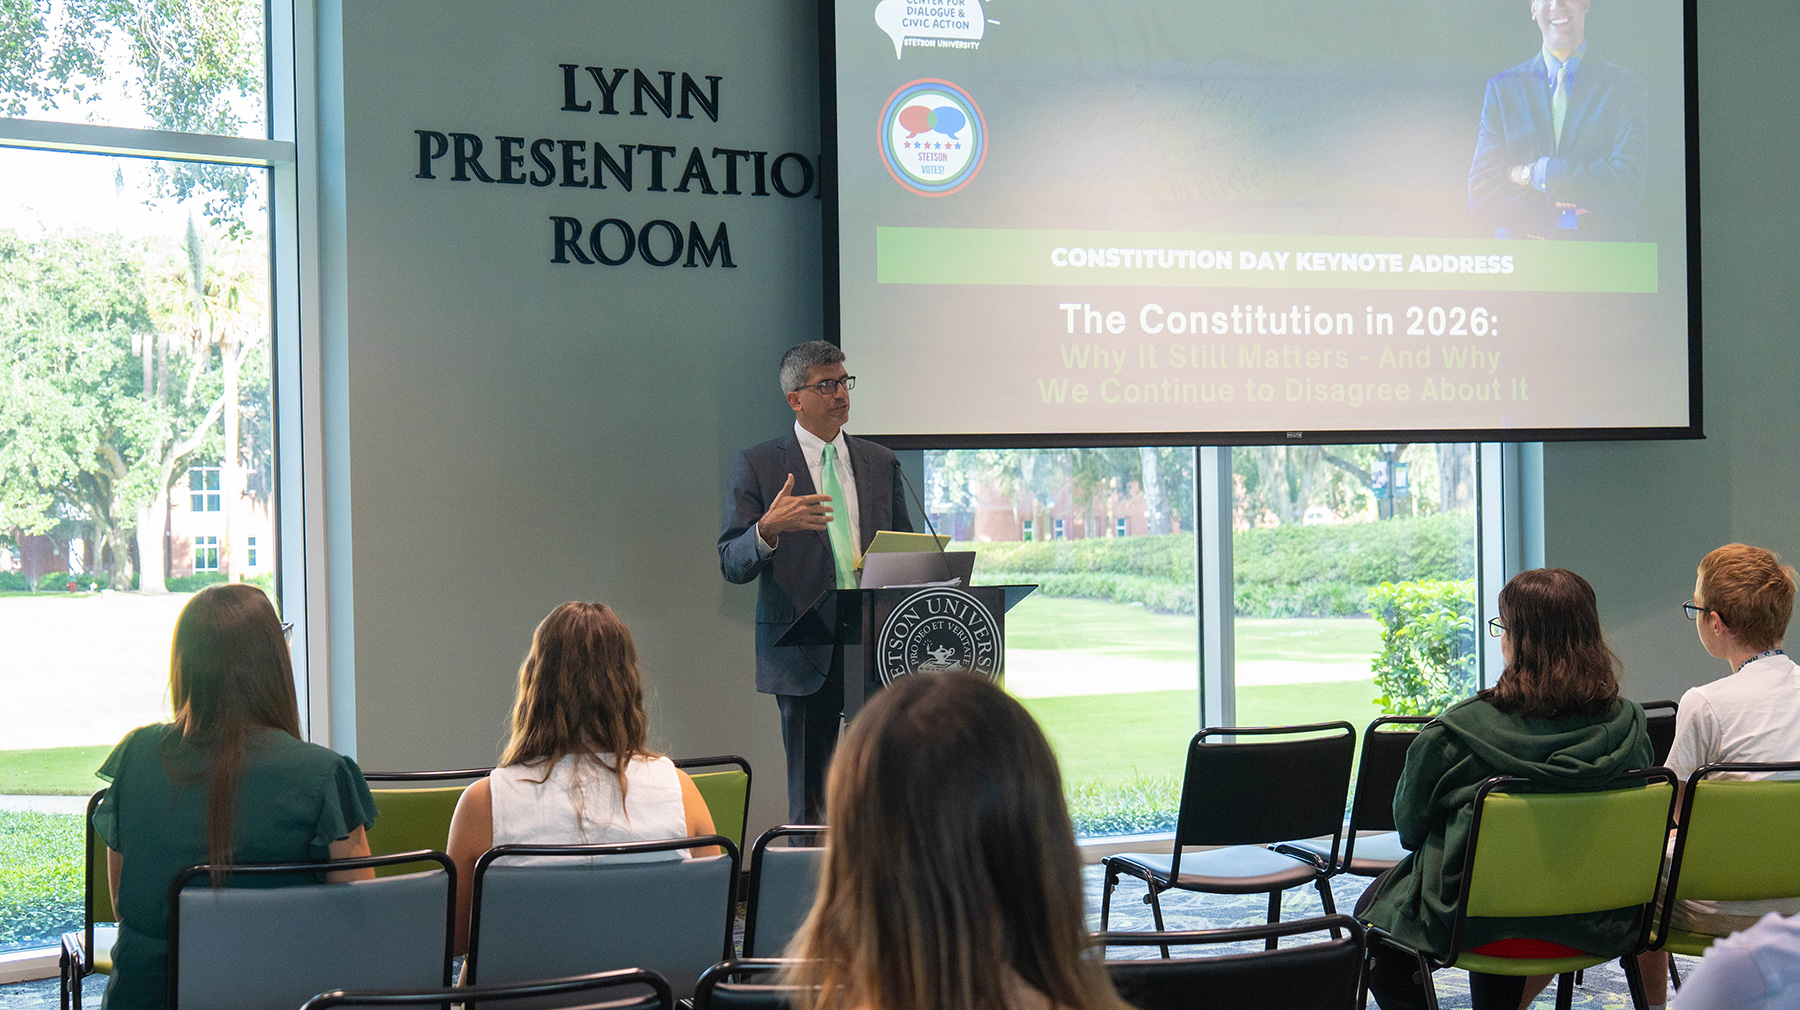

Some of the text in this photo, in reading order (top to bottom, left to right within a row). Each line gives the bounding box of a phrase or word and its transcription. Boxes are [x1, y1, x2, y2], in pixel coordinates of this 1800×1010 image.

[902, 17, 970, 30] CIVIC ACTION
[906, 6, 966, 18] DIALOGUE &
[903, 38, 980, 50] STETSON UNIVERSITY
[558, 63, 723, 123] LYNN
[414, 129, 821, 200] PRESENTATIO
[917, 151, 948, 162] STETSON
[921, 164, 945, 174] VOTES!
[549, 216, 737, 269] ROOM
[1050, 247, 1515, 274] CONSTITUTION DAY KEYNOTE ADDRESS
[1059, 303, 1498, 336] The Constitution in 2026:
[1059, 343, 1127, 375] Why
[1139, 343, 1158, 369] It
[1168, 343, 1228, 369] Still
[1238, 343, 1349, 369] Matters
[1378, 345, 1431, 369] And
[1441, 345, 1501, 375] Why
[1037, 377, 1528, 408] We Continue to Disagree About It
[888, 597, 992, 679] ETSON UNIVERSI
[910, 621, 971, 666] PRO DEO ET VERITATE
